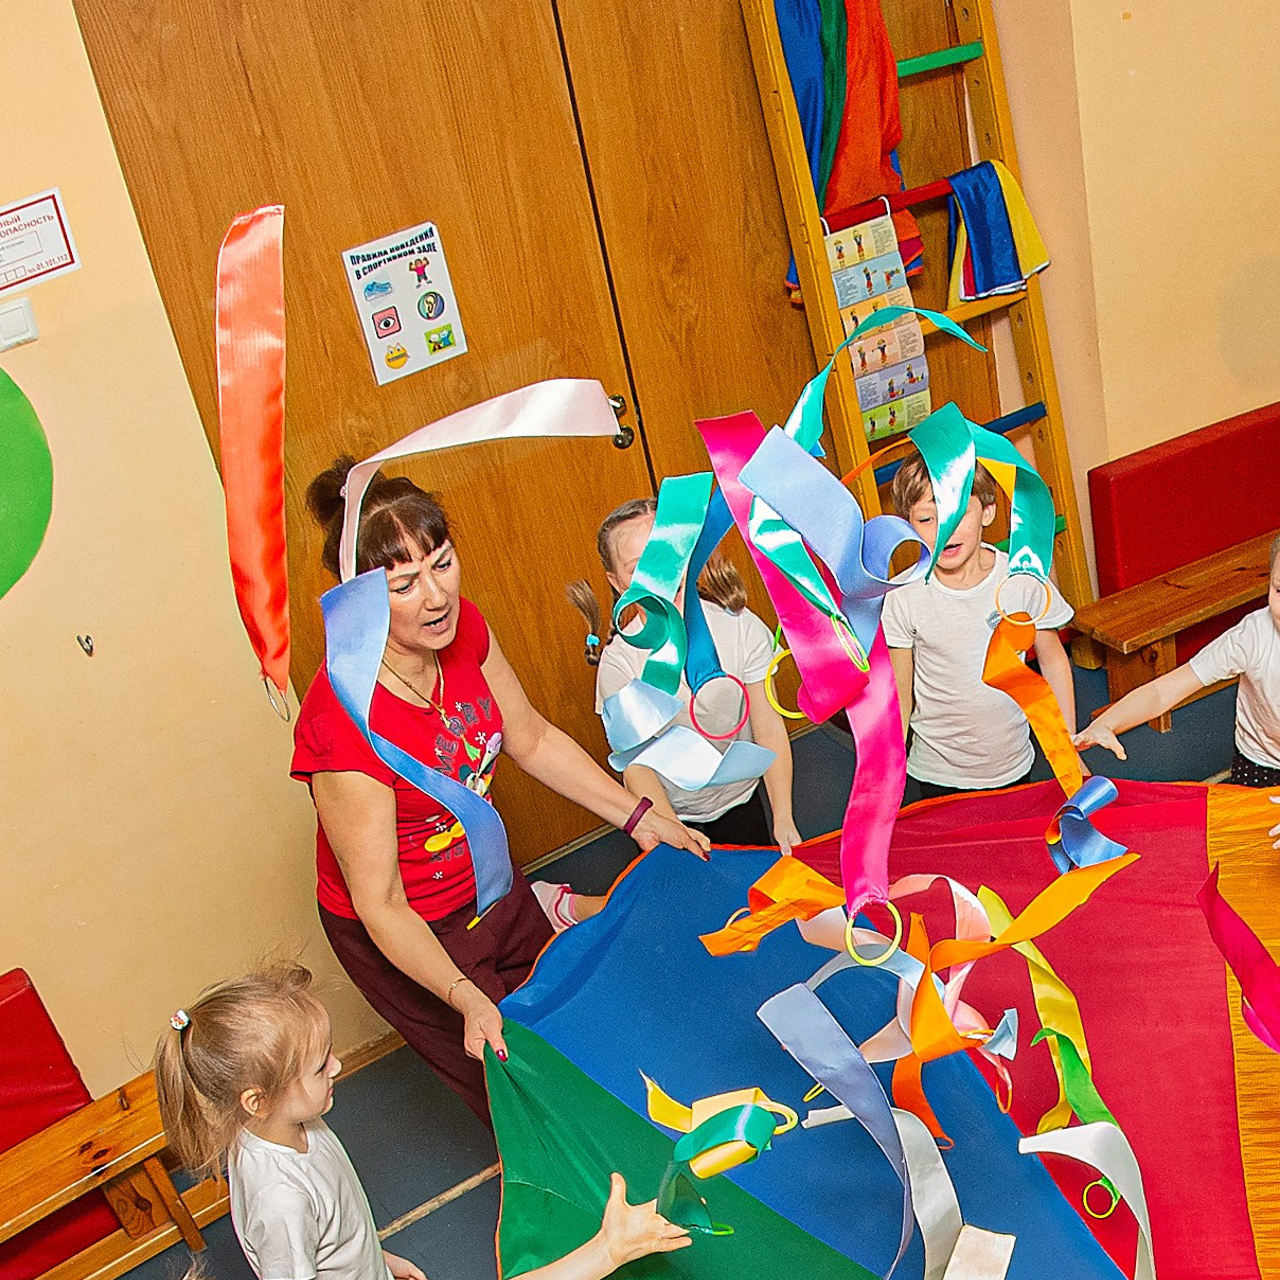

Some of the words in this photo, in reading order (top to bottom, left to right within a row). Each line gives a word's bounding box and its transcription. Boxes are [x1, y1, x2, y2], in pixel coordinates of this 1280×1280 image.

[349, 249, 389, 266] ПРАВИЛА
[389, 226, 435, 254] ПОВЕДЕНИЯ
[354, 269, 362, 281] В
[362, 248, 416, 276] СПОРТИВНОМ
[416, 241, 438, 254] ЗАЛЕ
[433, 697, 492, 776] MERRY
